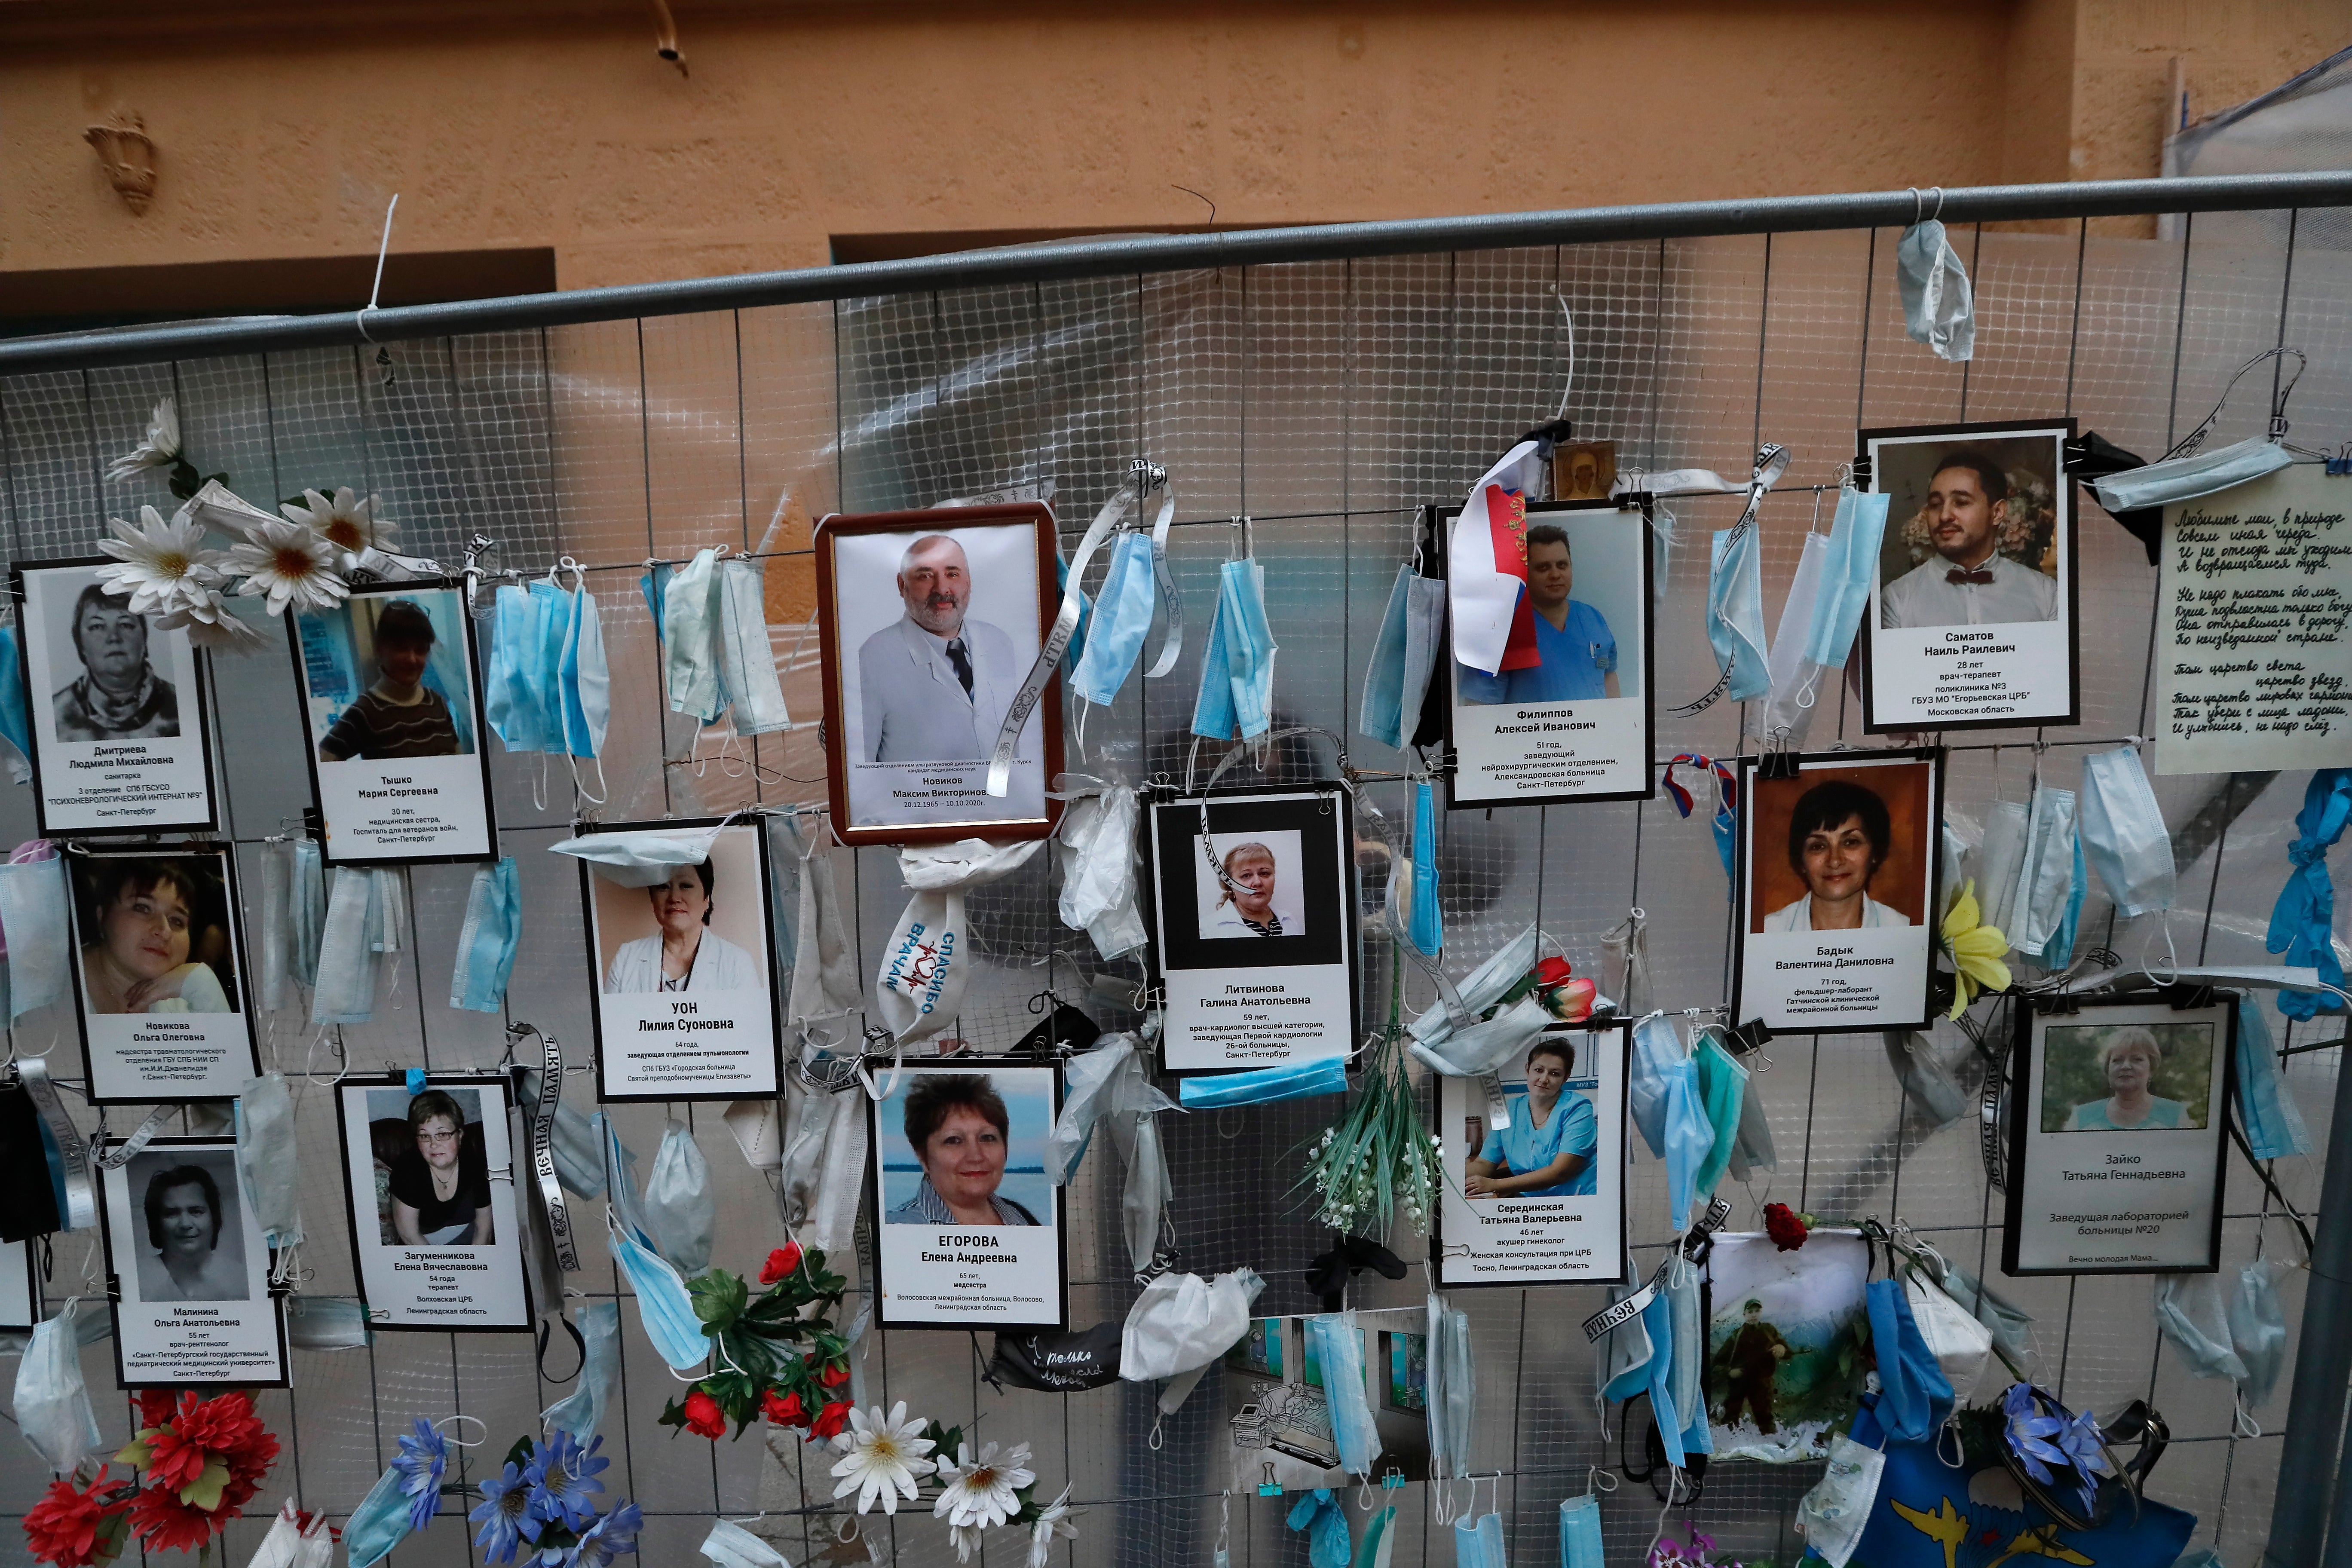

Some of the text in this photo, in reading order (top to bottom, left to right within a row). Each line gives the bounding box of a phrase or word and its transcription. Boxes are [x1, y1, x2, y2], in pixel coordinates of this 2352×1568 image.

[1946, 633, 1994, 642] Саматов
[1925, 645, 2015, 656] Наиль Раилевич
[1940, 672, 2001, 681] врач-терапевт
[1936, 685, 1989, 693] поликлиника
[1517, 710, 1573, 720] Филиппов
[1495, 722, 1596, 734] Алексей Иванович
[94, 747, 147, 757] Дмитриева
[1524, 750, 1575, 759] заведующий
[70, 756, 174, 769] Людмила Михайловна
[1482, 759, 1618, 772] нейрохирургическим отделением,
[1494, 772, 1565, 780] Александровская
[1517, 780, 1585, 789] Санкт-Петербург
[358, 788, 438, 799] Мария Сергеевна
[932, 790, 989, 798] Викторинов
[97, 808, 156, 816] Санкт-Петербург
[377, 835, 435, 843] Санкт-Петербург
[887, 922, 925, 991] ВРАЧАМ
[1817, 947, 1853, 956] Бадык
[1776, 958, 1894, 970] Валентина Даниловна
[921, 932, 955, 1014] СПАСИБО
[1225, 985, 1285, 994] Литвинова
[1795, 986, 1873, 996] фельдшер-лаборант
[1200, 997, 1311, 1008] Галина Анатольевна
[1831, 995, 1879, 1003] клинической
[672, 1002, 697, 1014] УОН
[1787, 1005, 1838, 1014] межрайонной
[639, 1019, 734, 1033] Лилия Суоновна
[1189, 1025, 1250, 1033] врач-кардиолог
[1243, 1032, 1271, 1041] Первой
[650, 1074, 714, 1082] преподобномученицы
[2105, 1154, 2141, 1164] Зайко
[2062, 1170, 2185, 1181] Татьяна Геннадьевна
[1498, 1204, 1564, 1214] Серединская
[1523, 1215, 1582, 1224] Валерьевна
[2049, 1211, 2189, 1224] Заведущая лабораторией
[2078, 1226, 2132, 1235] больницы
[939, 1235, 999, 1247] ЕГОРОВА
[405, 1252, 475, 1262] Загуменникова
[1575, 1249, 1591, 1257] ЦРБ
[922, 1252, 1017, 1265] Елена Андреевна
